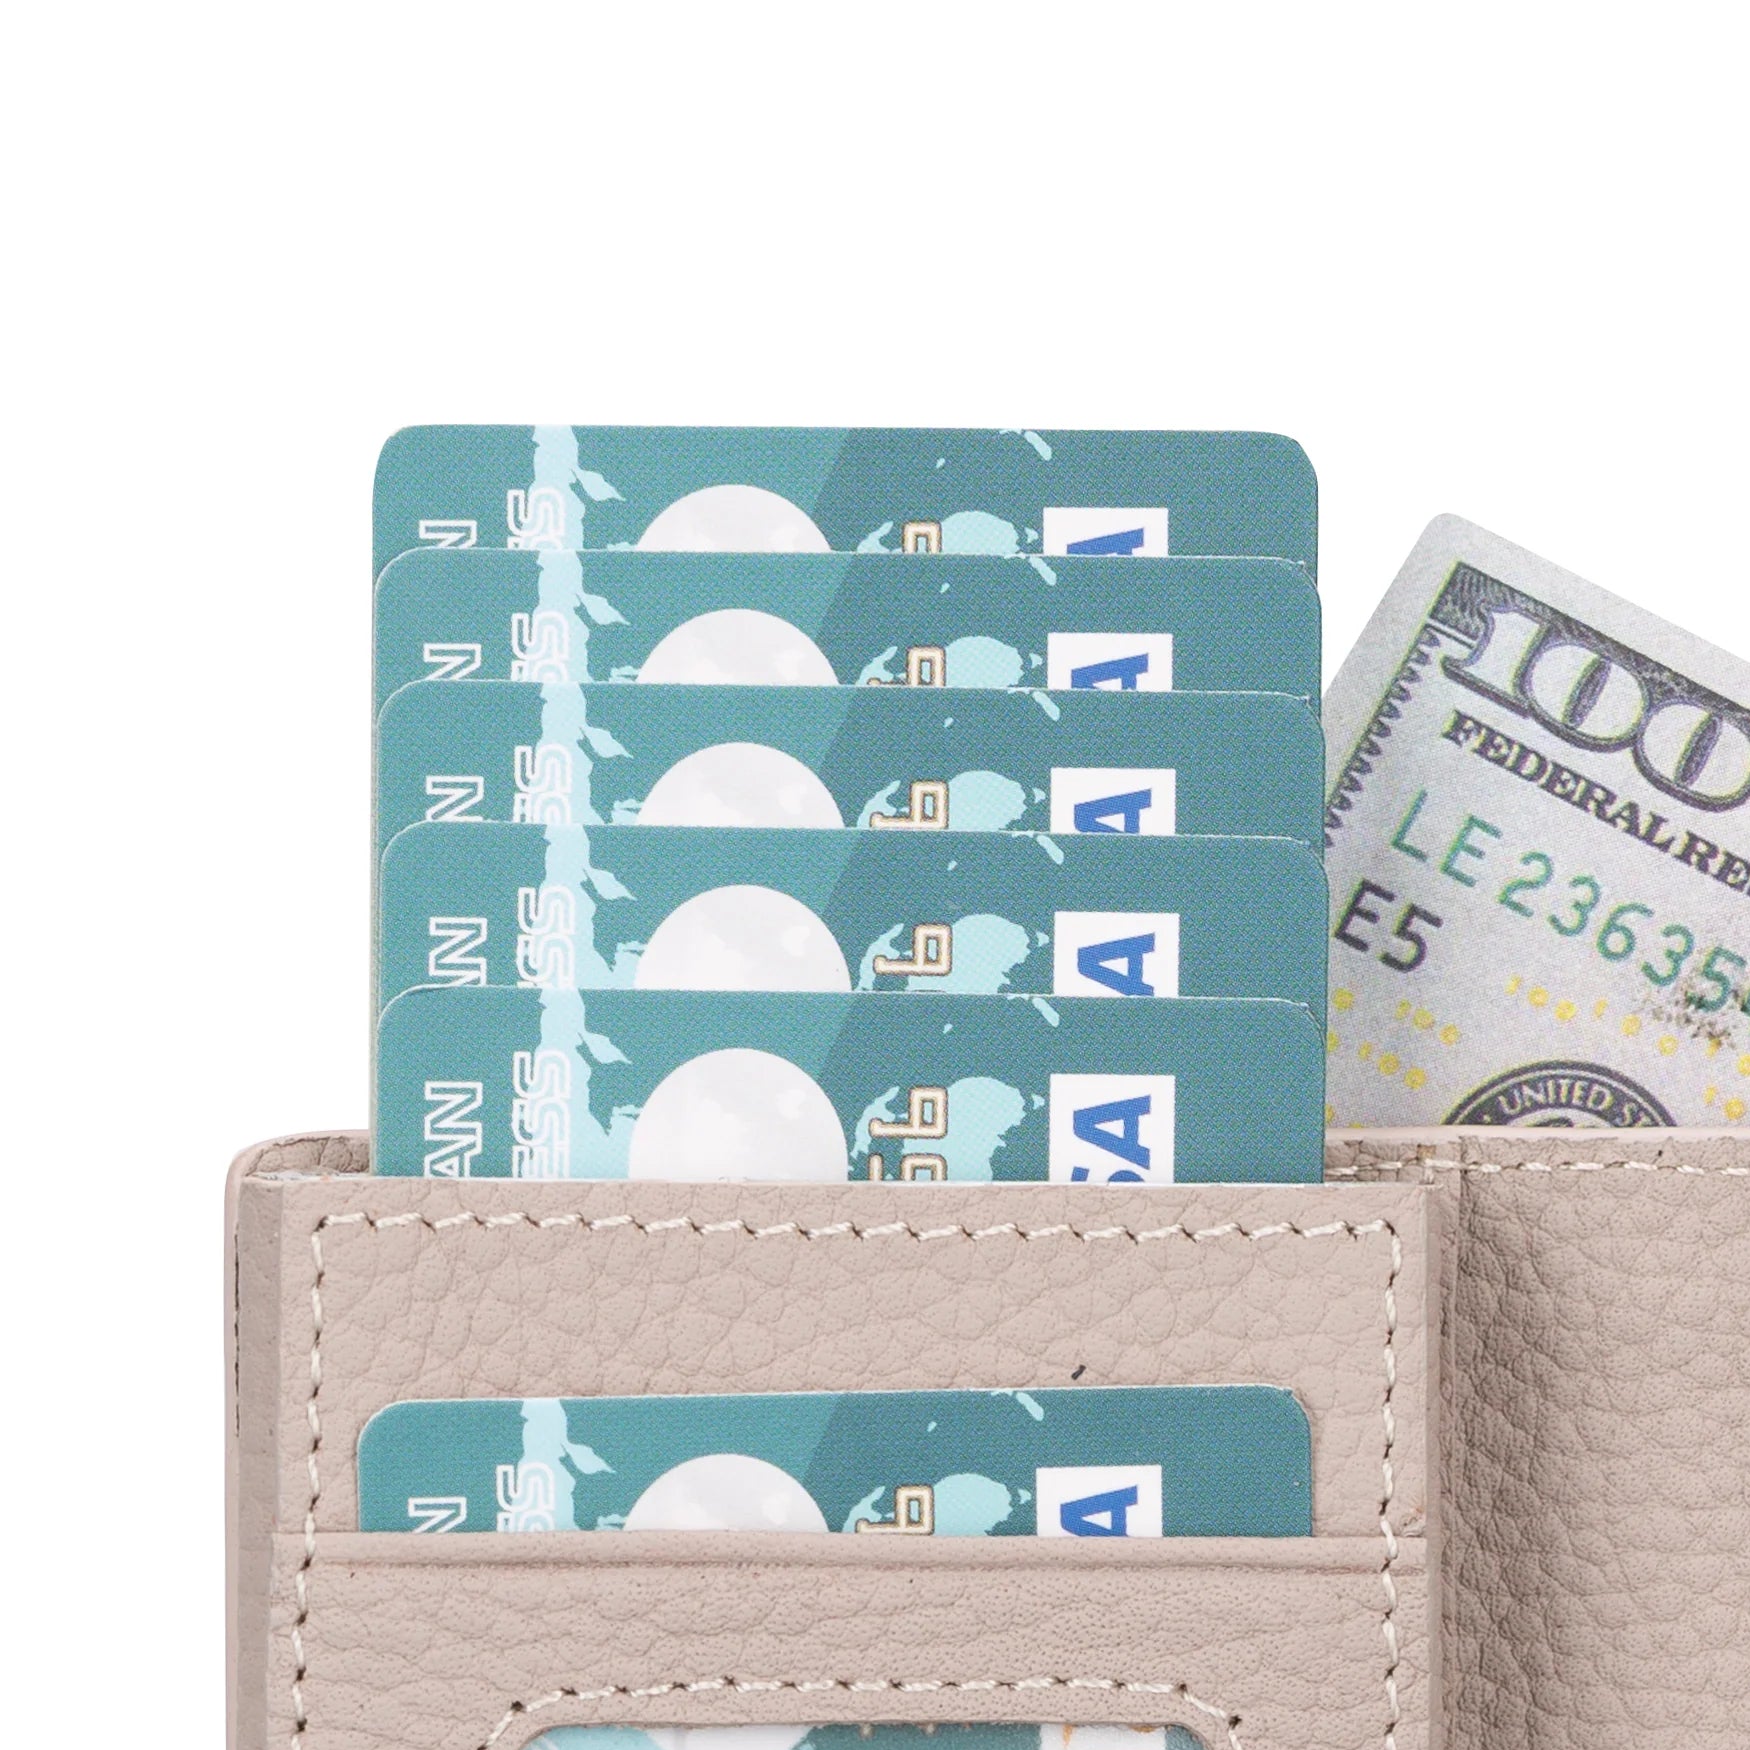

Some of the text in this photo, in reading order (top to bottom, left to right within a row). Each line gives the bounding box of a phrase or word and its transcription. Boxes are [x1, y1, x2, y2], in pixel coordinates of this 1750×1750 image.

[1440, 707, 1678, 852] FEDERAL
[516, 884, 576, 988] SS
[1333, 877, 1444, 972] E5
[1498, 1079, 1614, 1116] UNITED
